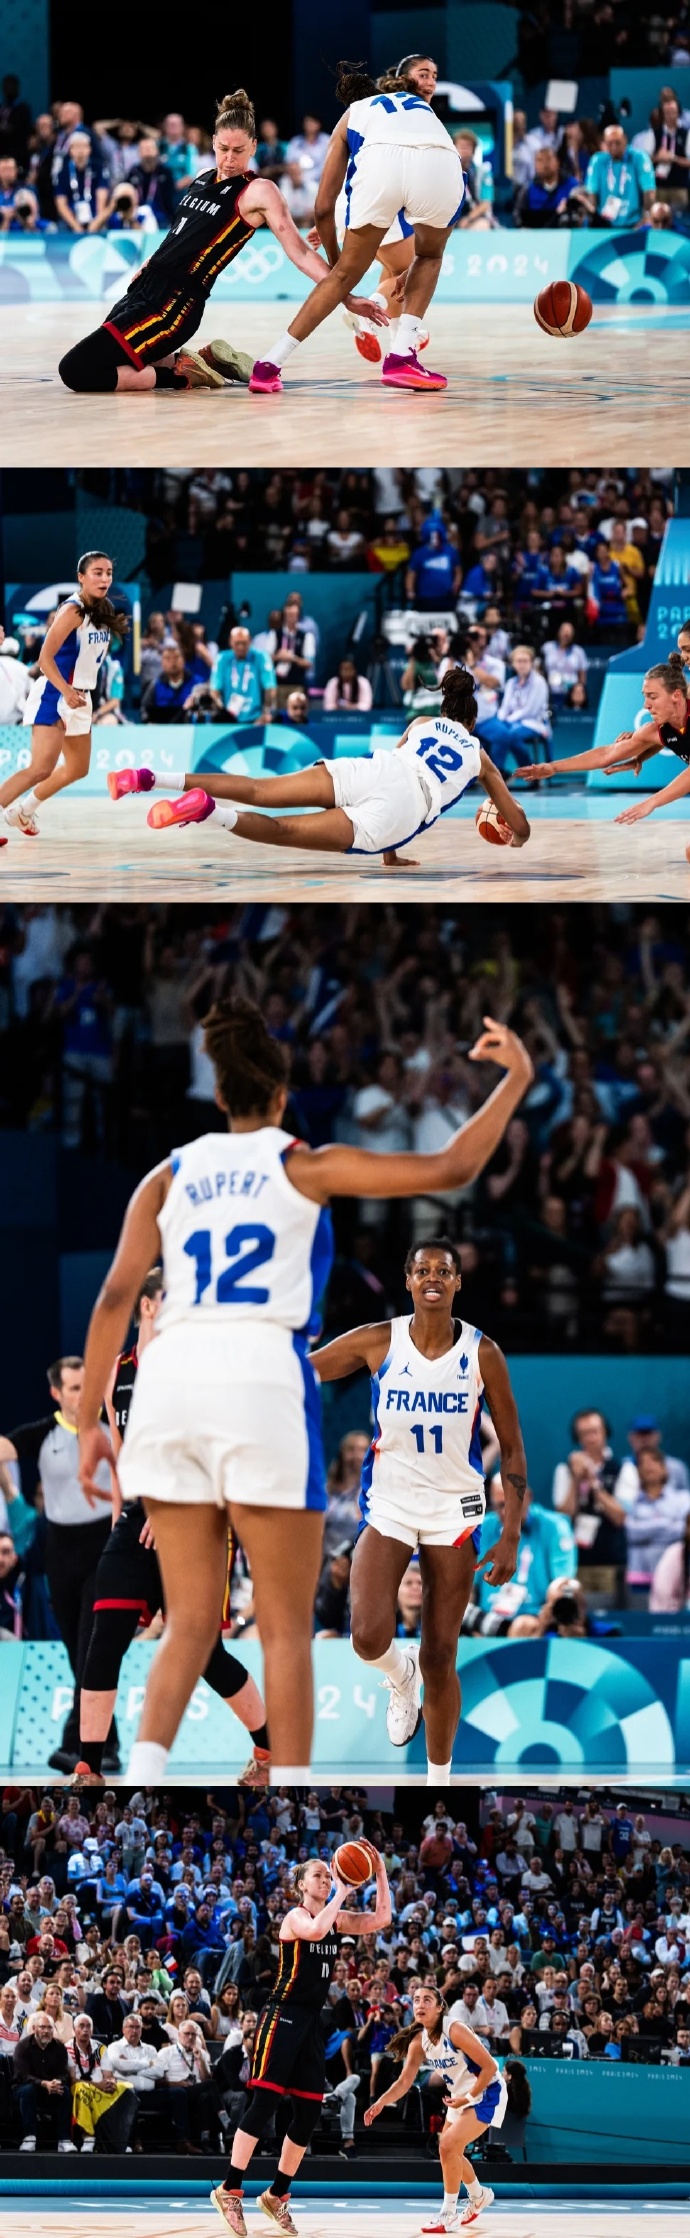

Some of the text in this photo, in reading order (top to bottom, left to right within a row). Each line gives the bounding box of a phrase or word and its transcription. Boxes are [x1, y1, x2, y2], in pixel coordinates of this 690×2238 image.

[370, 91, 433, 113] 12
[467, 254, 549, 277] 2024
[435, 722, 474, 749] RUPERT
[96, 749, 174, 769] 2024
[416, 737, 463, 784] 12
[185, 1171, 269, 1207] RUPERT
[183, 1223, 276, 1305] 12
[386, 1389, 469, 1413] FRANCE
[410, 1424, 443, 1454] 11
